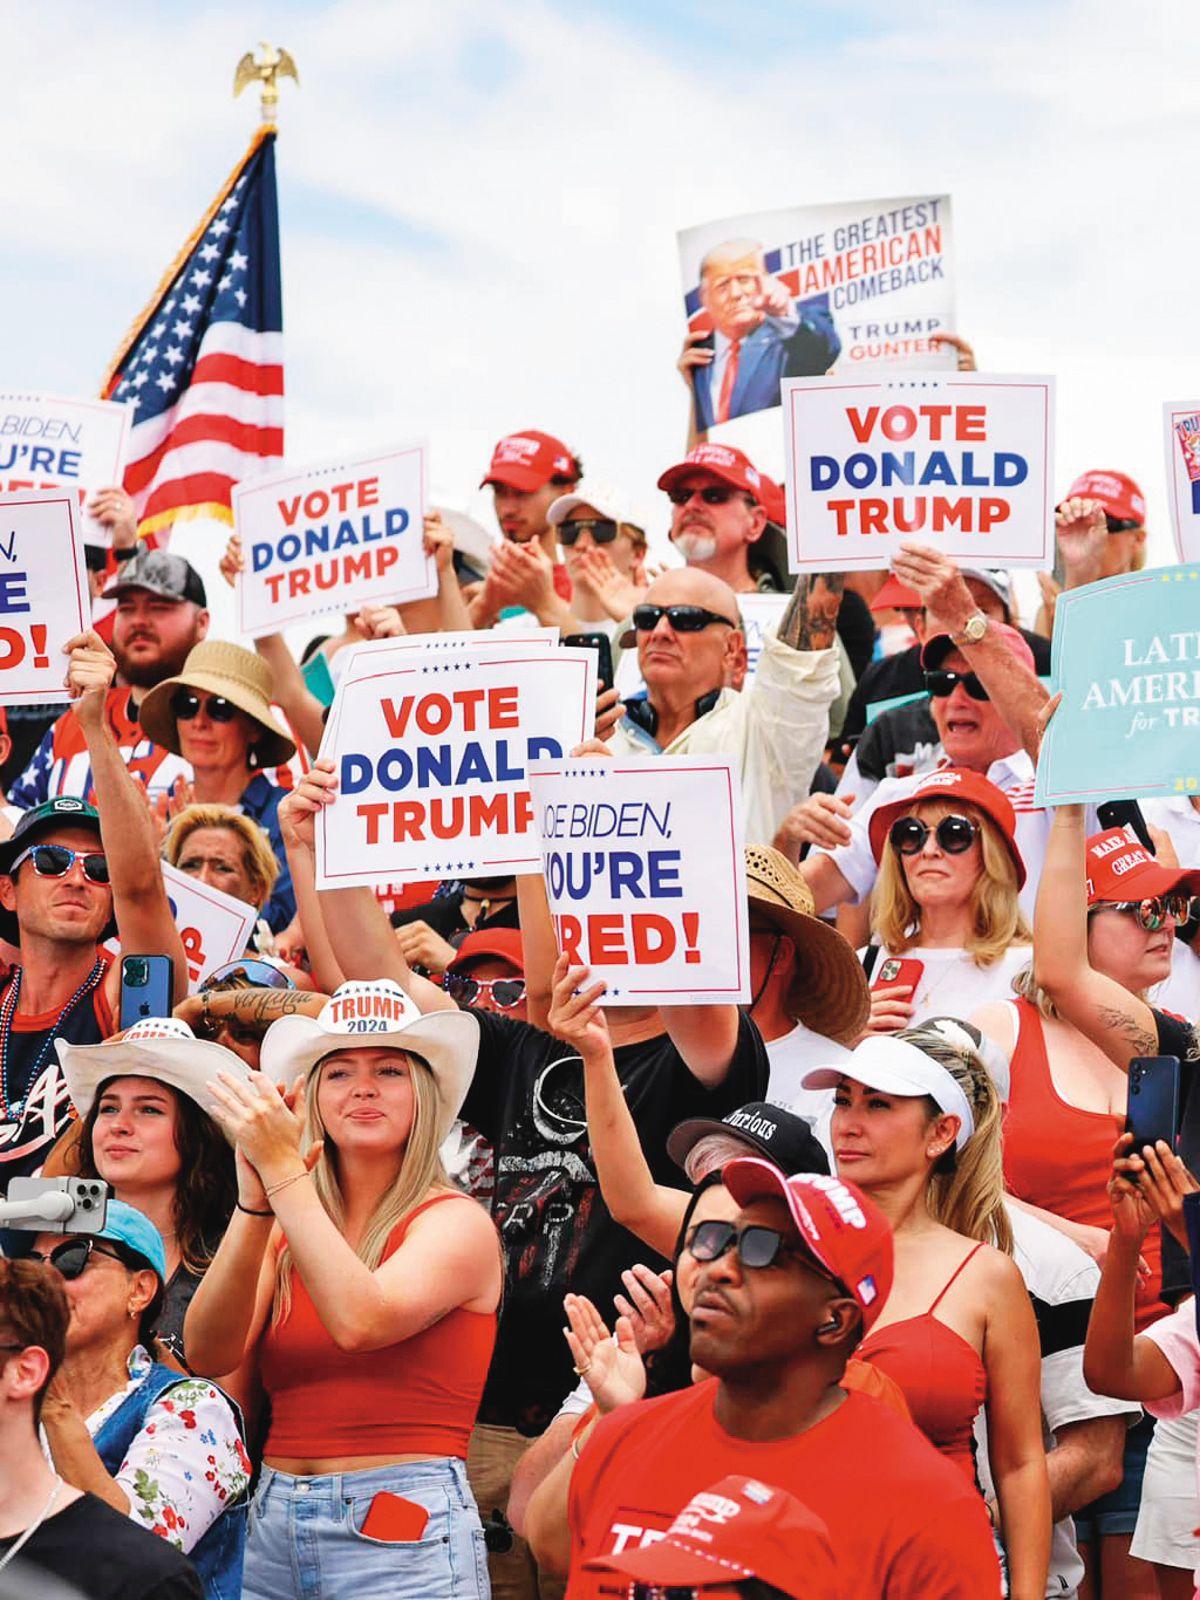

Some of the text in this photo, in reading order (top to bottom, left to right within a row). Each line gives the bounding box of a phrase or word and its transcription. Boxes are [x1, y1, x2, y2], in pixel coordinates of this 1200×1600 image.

[786, 199, 941, 267] THE GREATEST
[804, 223, 942, 294] AMERICAN
[833, 257, 944, 310] COMEBACK
[849, 318, 941, 341] TRUMP
[849, 338, 942, 361] GUNTER
[845, 404, 987, 443] VOTE
[810, 450, 1029, 492] DONALD
[277, 475, 380, 527] VOTE
[826, 496, 1011, 537] TRUMP
[251, 506, 409, 573] DONALD
[264, 545, 399, 605] TRUMP
[380, 686, 520, 739] VOTE
[1124, 711, 1159, 738] for
[569, 801, 672, 839] BIDEN,
[330, 995, 405, 1024] TRUMP
[347, 1019, 388, 1033] 2024
